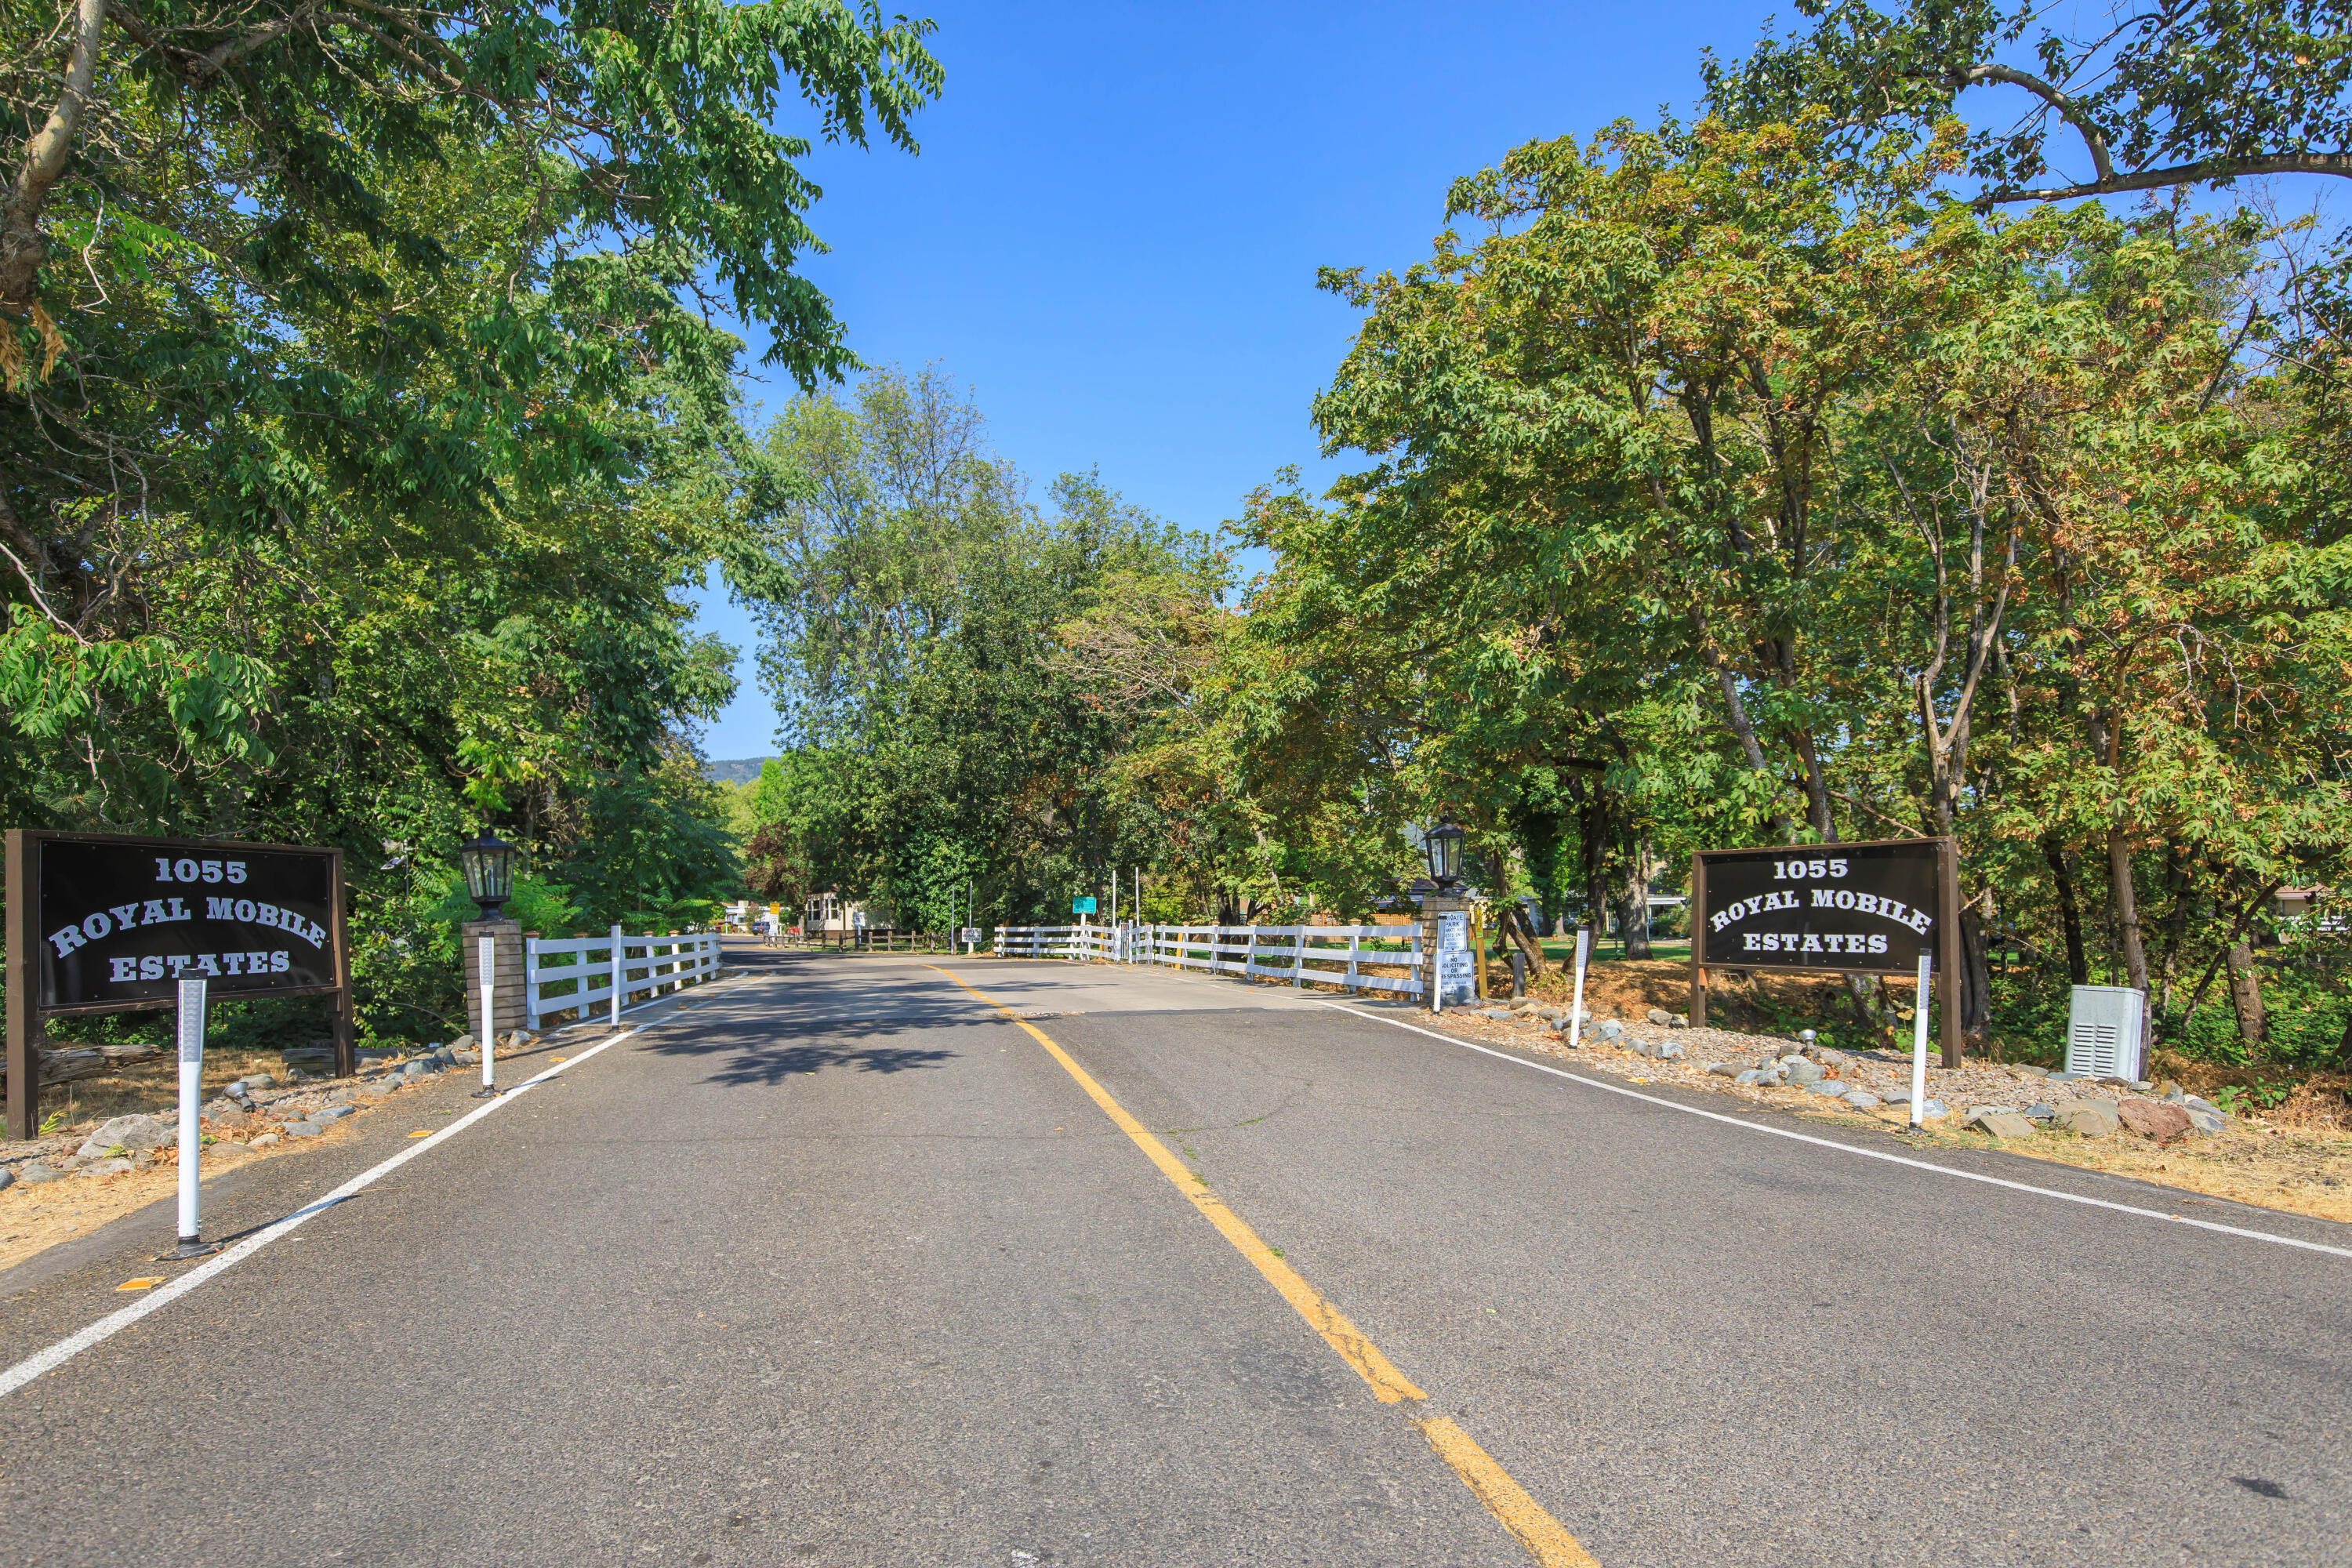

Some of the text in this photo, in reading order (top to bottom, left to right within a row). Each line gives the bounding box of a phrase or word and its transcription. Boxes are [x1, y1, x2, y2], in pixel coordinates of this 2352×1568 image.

[156, 858, 248, 884] 1055
[1773, 859, 1849, 880] 1055
[1710, 889, 1933, 935] ROYAL MOBILE
[49, 897, 327, 959] ROYAL MOBILE
[1743, 933, 1889, 954] ESTATES
[109, 950, 290, 982] ESTATES
